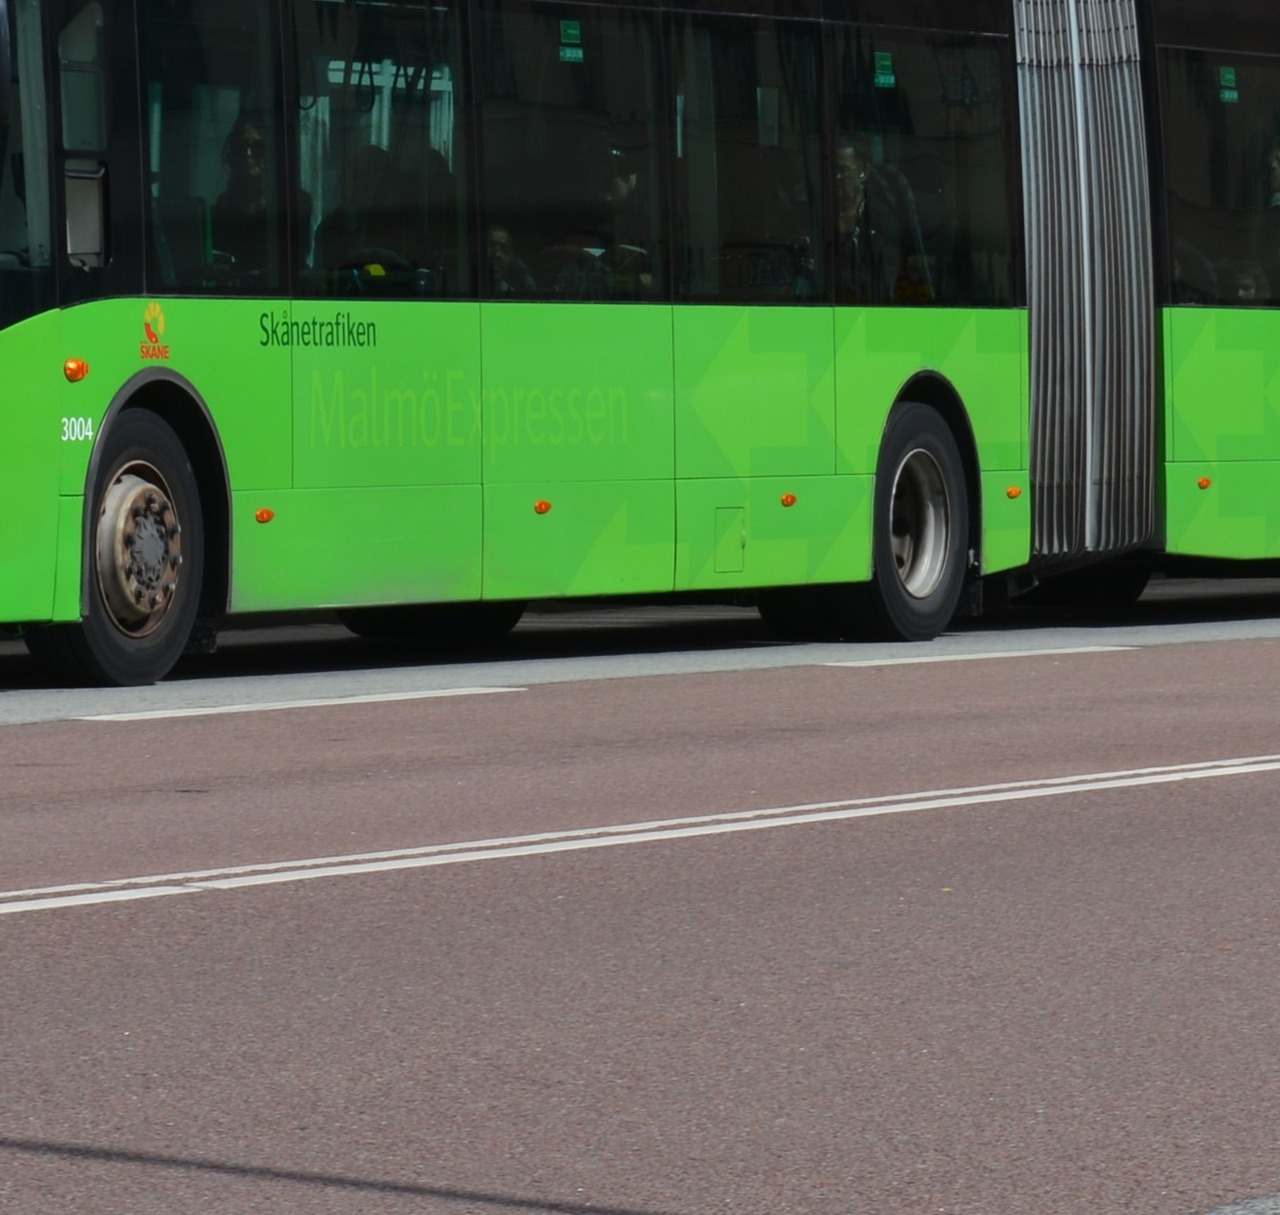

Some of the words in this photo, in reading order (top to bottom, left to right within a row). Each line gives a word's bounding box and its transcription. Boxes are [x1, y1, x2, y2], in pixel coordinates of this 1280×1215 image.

[259, 309, 377, 347] Skånetrafiken
[60, 416, 94, 441] 3004
[309, 366, 629, 464] MalmöExpressen
